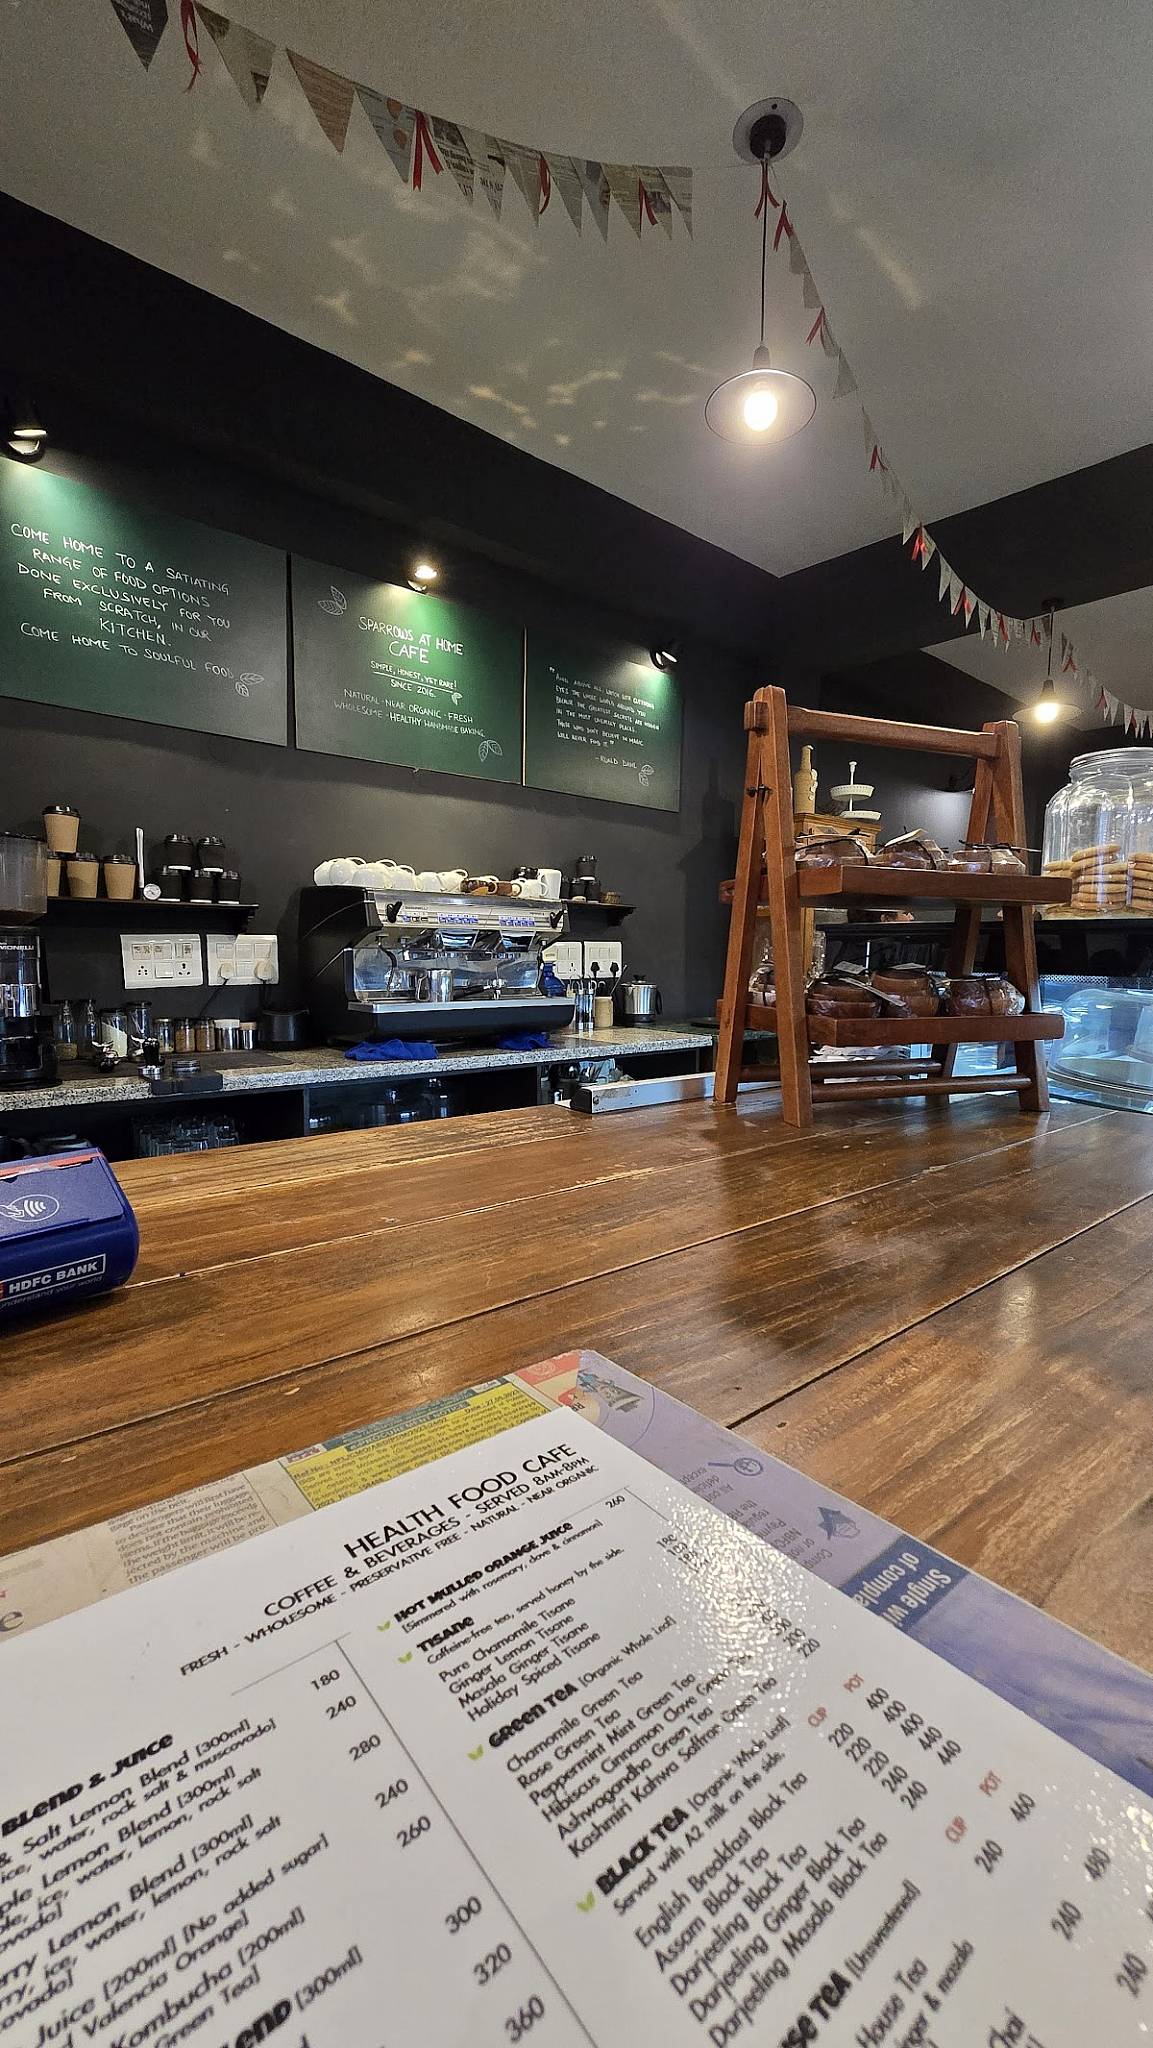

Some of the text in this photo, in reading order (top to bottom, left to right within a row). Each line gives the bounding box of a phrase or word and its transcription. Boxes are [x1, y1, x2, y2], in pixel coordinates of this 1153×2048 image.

[11, 523, 229, 596] COME HOME TO A SATIATING
[32, 548, 210, 607] RANGE OF FOOD OPTIONS
[17, 562, 230, 629] DONE EXCLUSIVELY FOR YOU
[43, 588, 211, 642] FROM SCRATCH, IN OUR
[20, 622, 235, 679] COME HOME TO SOULFUL FOOD
[99, 617, 173, 647] KITCHEN.
[358, 616, 464, 656] SPARROWS AT HOME
[388, 641, 429, 664] CAFE
[390, 679, 412, 692] SINCE
[424, 676, 437, 685] YET
[334, 702, 383, 719] WHOLESOME
[424, 719, 459, 734] HANDMADE
[344, 688, 380, 705] NATURAL
[408, 704, 442, 719] ORGANIC
[448, 712, 473, 724] FRESH
[9, 1274, 51, 1293] HDFC
[56, 1261, 98, 1280] BANK
[344, 1444, 576, 1558] HEALTH FOOD CAFE
[605, 1495, 625, 1509] 260
[209, 1538, 231, 1551] will
[232, 1532, 246, 1542] be
[264, 1456, 589, 1616] COFFEE & BEVERAGES SERVED 8AM-8PM
[180, 1466, 599, 1676] FRESH WHOLESOME PRESERVATIVE FREE NATURAL NEAR ORGANIC
[459, 1586, 480, 1602] with
[482, 1562, 527, 1591] rosemary,
[529, 1550, 551, 1564] clove
[553, 1543, 560, 1551] &
[900, 1552, 919, 1572] of
[394, 1599, 426, 1622] HOT
[427, 1623, 494, 1665] Caffeine-free
[495, 1613, 515, 1627] tea,
[516, 1593, 546, 1615] served
[546, 1576, 575, 1595] honey
[574, 1567, 588, 1578] by
[588, 1558, 604, 1570] the
[900, 1568, 952, 1611] Single
[439, 1597, 576, 1682] Pure Chamomile Tisane
[449, 1614, 574, 1694] Ginger Lemon Tisane
[311, 1669, 340, 1691] 180
[459, 1621, 589, 1708] Masala Ginger Tisane
[467, 1632, 601, 1722] Holiday Spiced Tisane
[326, 1695, 357, 1720] 240
[506, 1670, 643, 1772] Chamomile Green Tea
[808, 1673, 864, 1728] CUP POT
[828, 1687, 890, 1749] 220 400
[349, 1734, 381, 1761] 280
[517, 1708, 621, 1790] Rose Green Tea
[23, 1718, 251, 1854] Salt Lemon Blend [300ml]
[89, 1774, 105, 1788] &
[374, 1779, 409, 1808] 240
[396, 1815, 431, 1848] 260
[634, 1772, 808, 1948] English Breakfast Black Tea
[445, 1896, 482, 1934] 300
[473, 1943, 512, 1986] 320
[505, 1994, 545, 2043] 360
